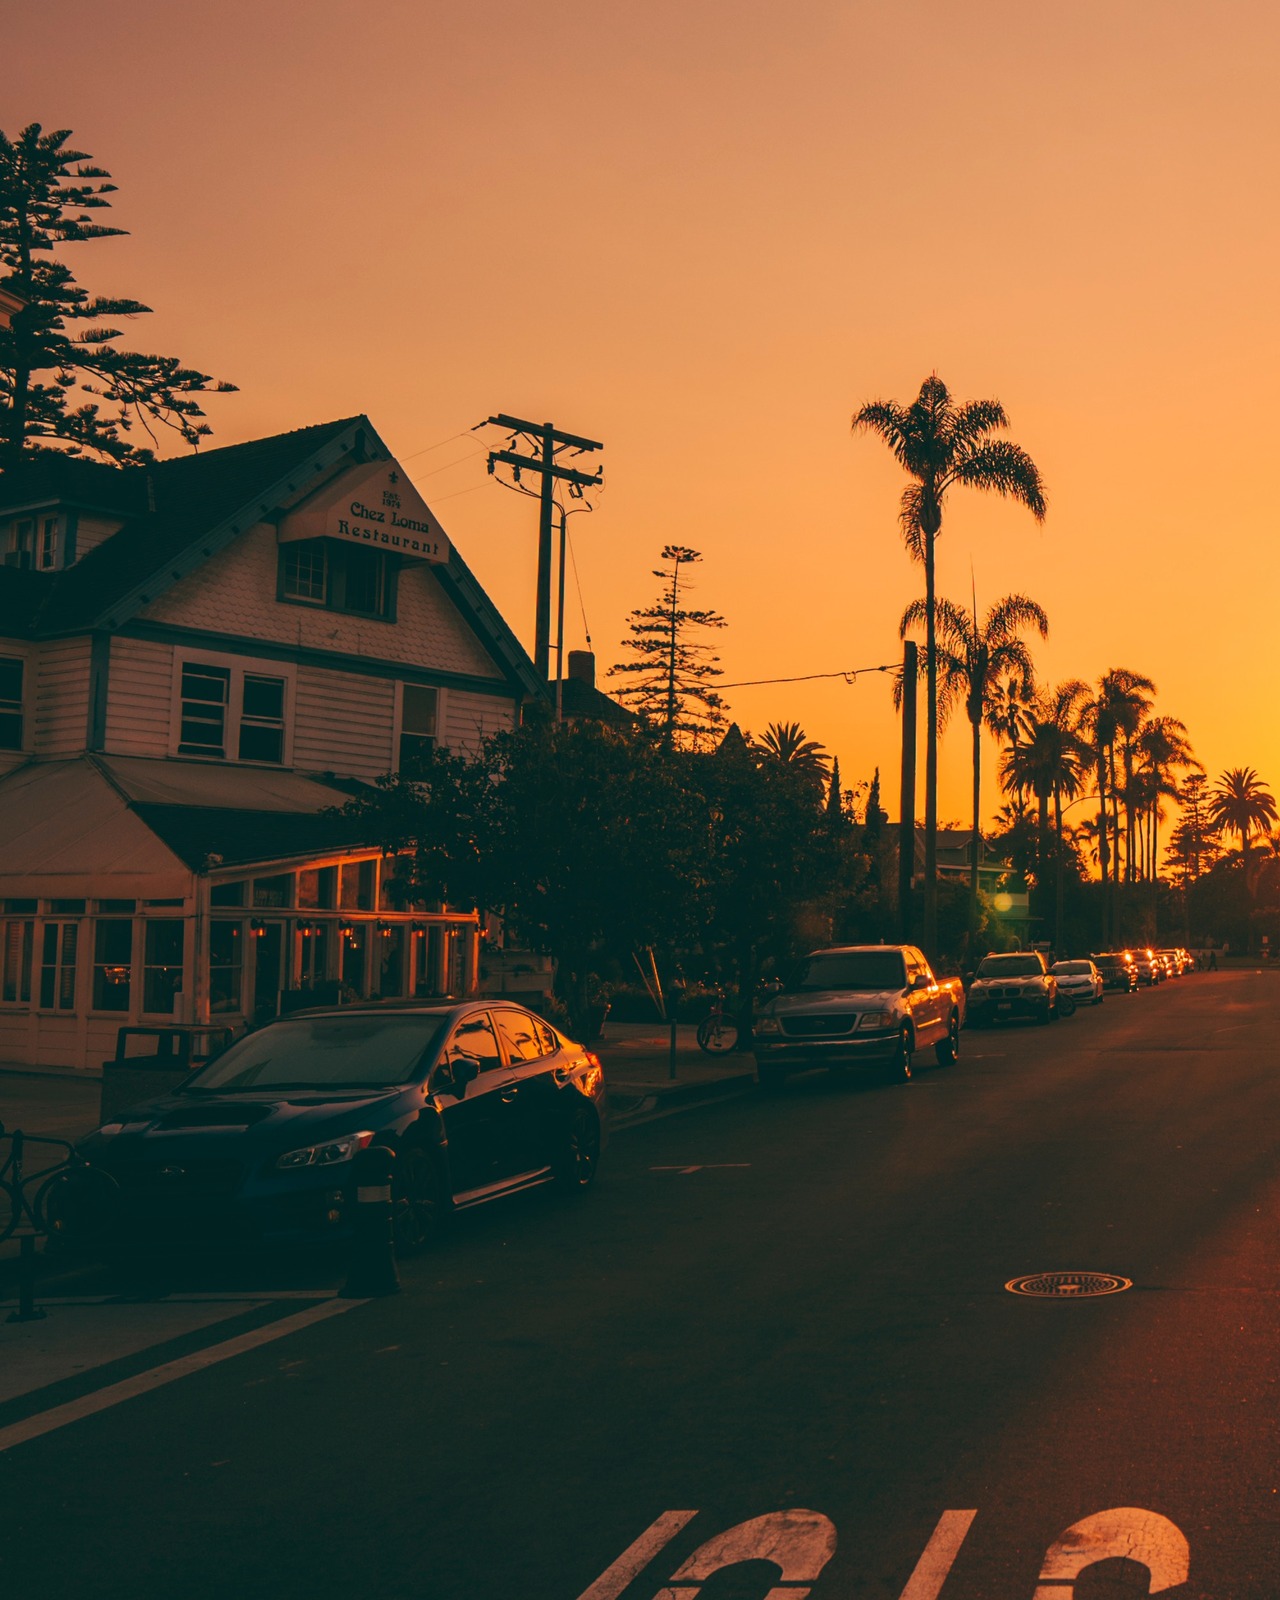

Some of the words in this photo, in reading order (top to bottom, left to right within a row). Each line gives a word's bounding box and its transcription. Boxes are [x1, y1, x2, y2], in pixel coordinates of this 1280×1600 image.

[350, 502, 385, 523] Chez
[391, 511, 429, 534] Loma
[382, 498, 401, 509] 1974
[338, 519, 439, 555] Restaurant
